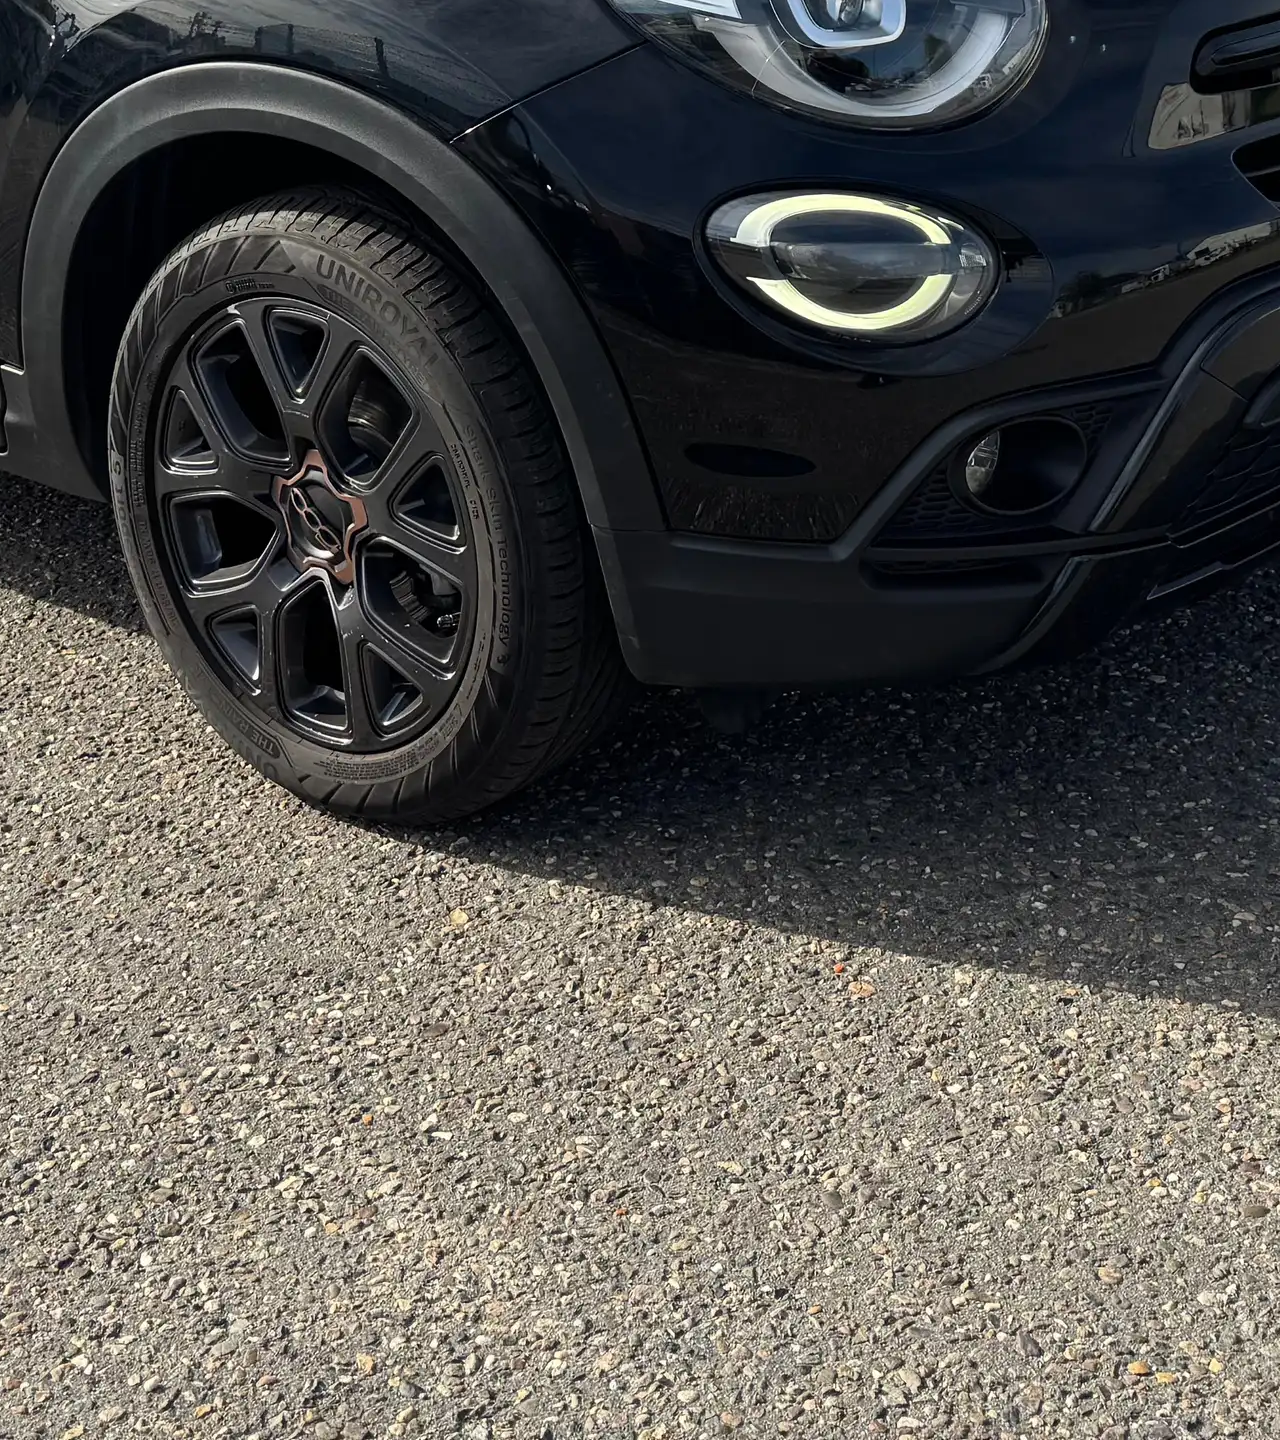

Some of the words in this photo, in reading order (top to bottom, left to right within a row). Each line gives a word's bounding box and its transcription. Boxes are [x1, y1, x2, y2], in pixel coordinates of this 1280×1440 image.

[315, 253, 440, 372] UNIROYAL
[486, 486, 502, 531] Skin
[495, 536, 513, 648] Technology
